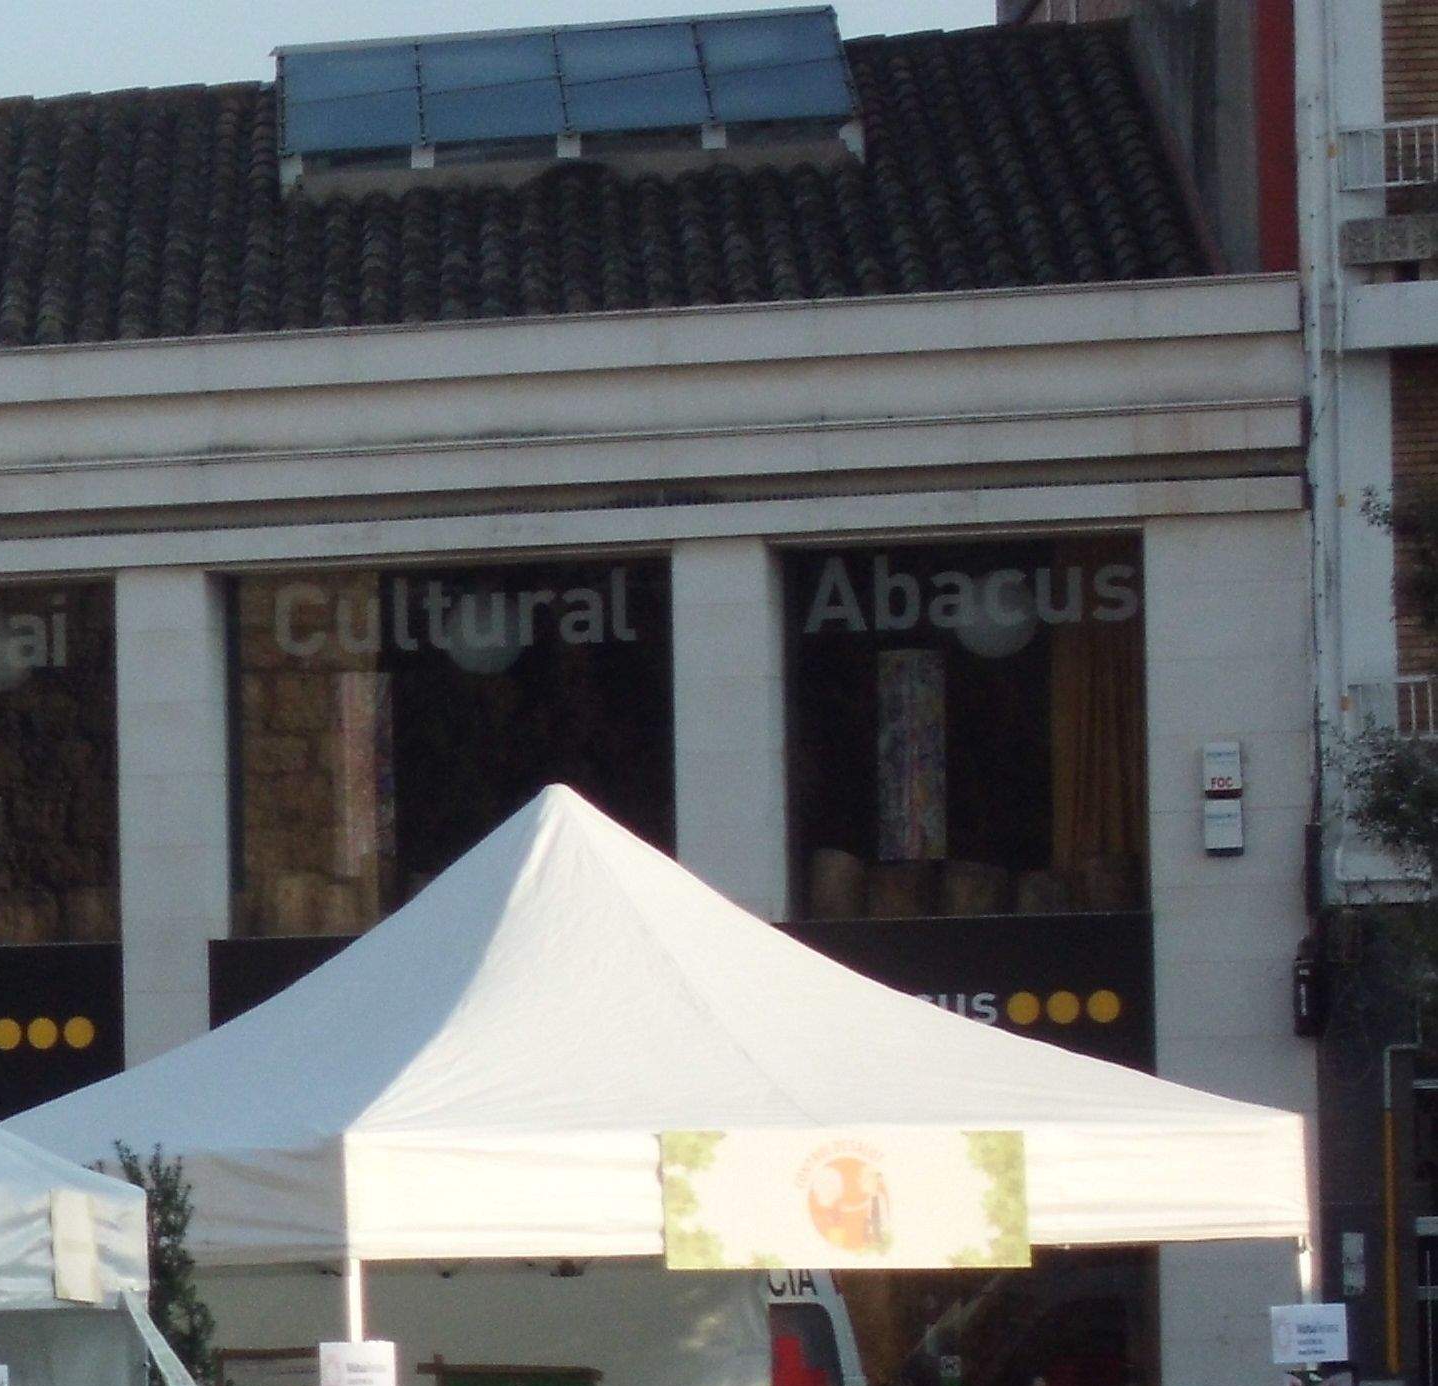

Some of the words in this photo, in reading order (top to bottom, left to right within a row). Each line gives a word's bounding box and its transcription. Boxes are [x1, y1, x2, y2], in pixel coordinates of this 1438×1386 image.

[274, 566, 637, 656] Cultural
[802, 553, 1138, 634] Abacus
[1211, 775, 1234, 788] FOC
